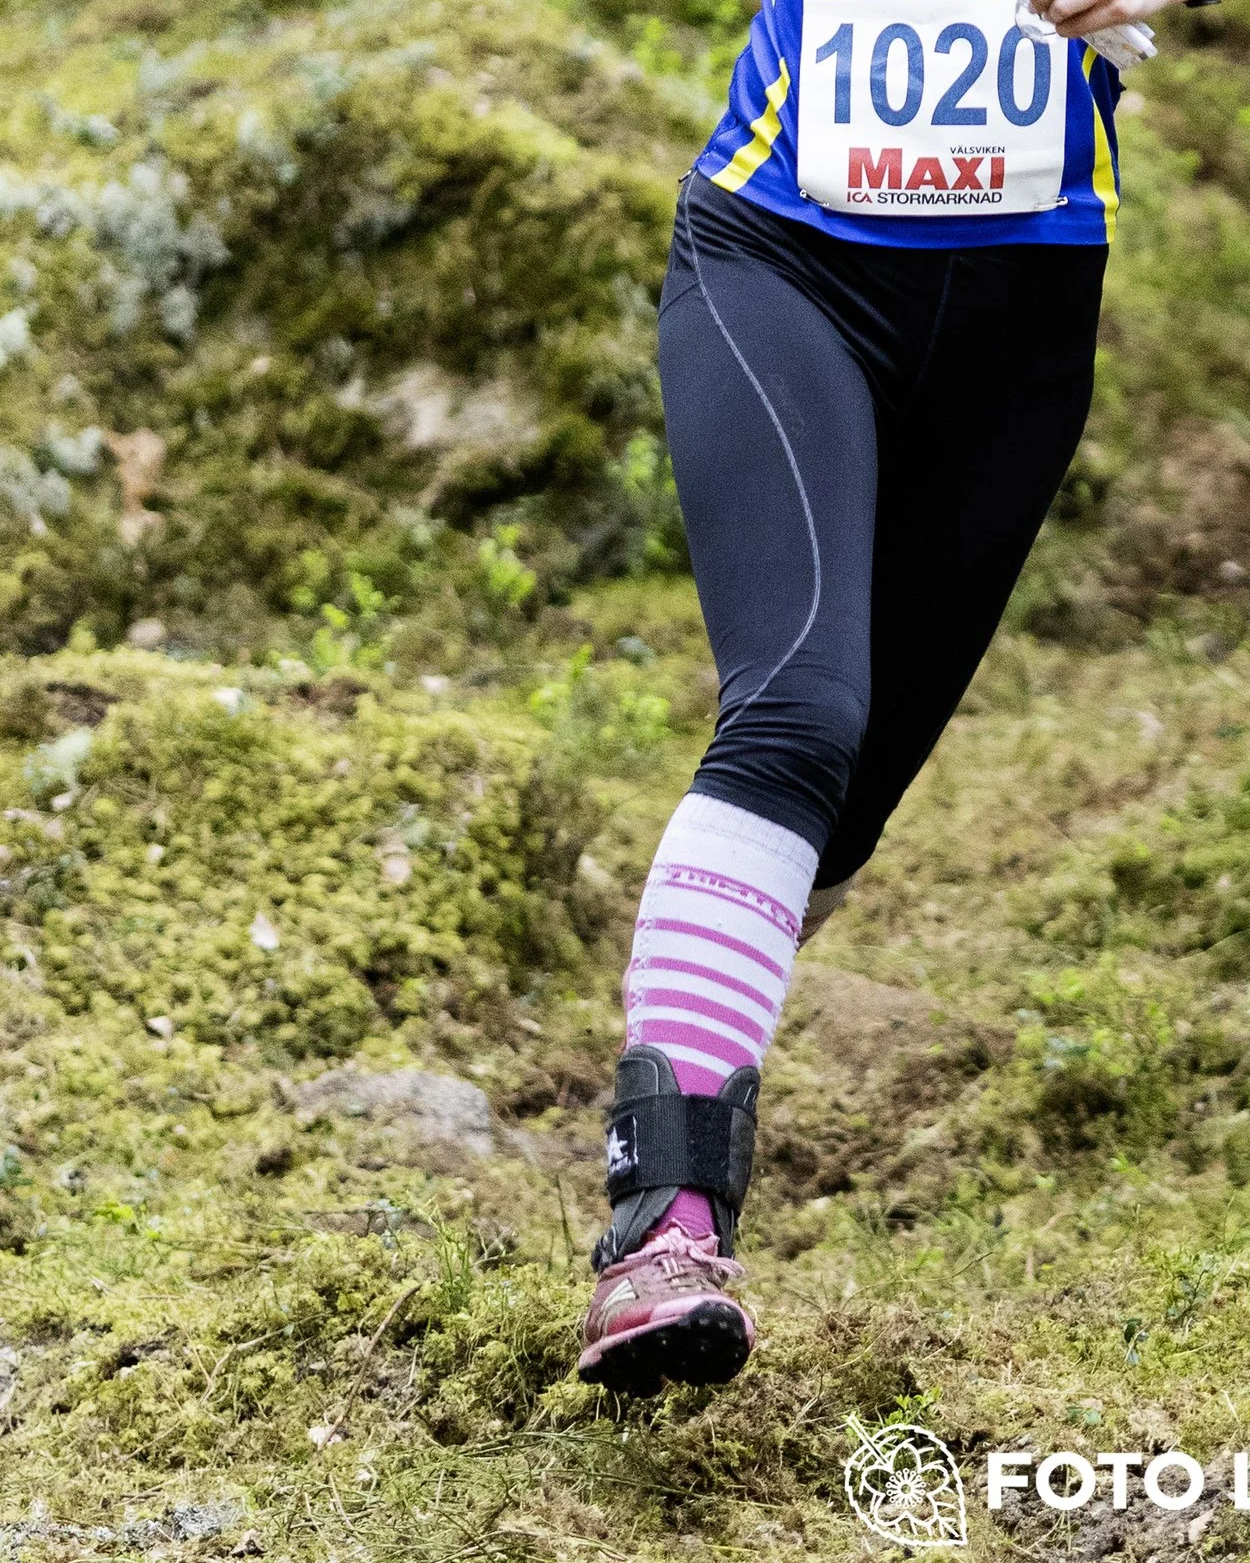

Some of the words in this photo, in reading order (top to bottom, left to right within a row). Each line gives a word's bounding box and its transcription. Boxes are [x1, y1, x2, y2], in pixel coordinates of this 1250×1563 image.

[815, 22, 1051, 127] 1020
[949, 145, 1006, 155] VÄLSVIKEN
[847, 147, 1006, 191] MAXI
[846, 191, 873, 204] ICA
[877, 191, 1003, 205] STORMARKNAD
